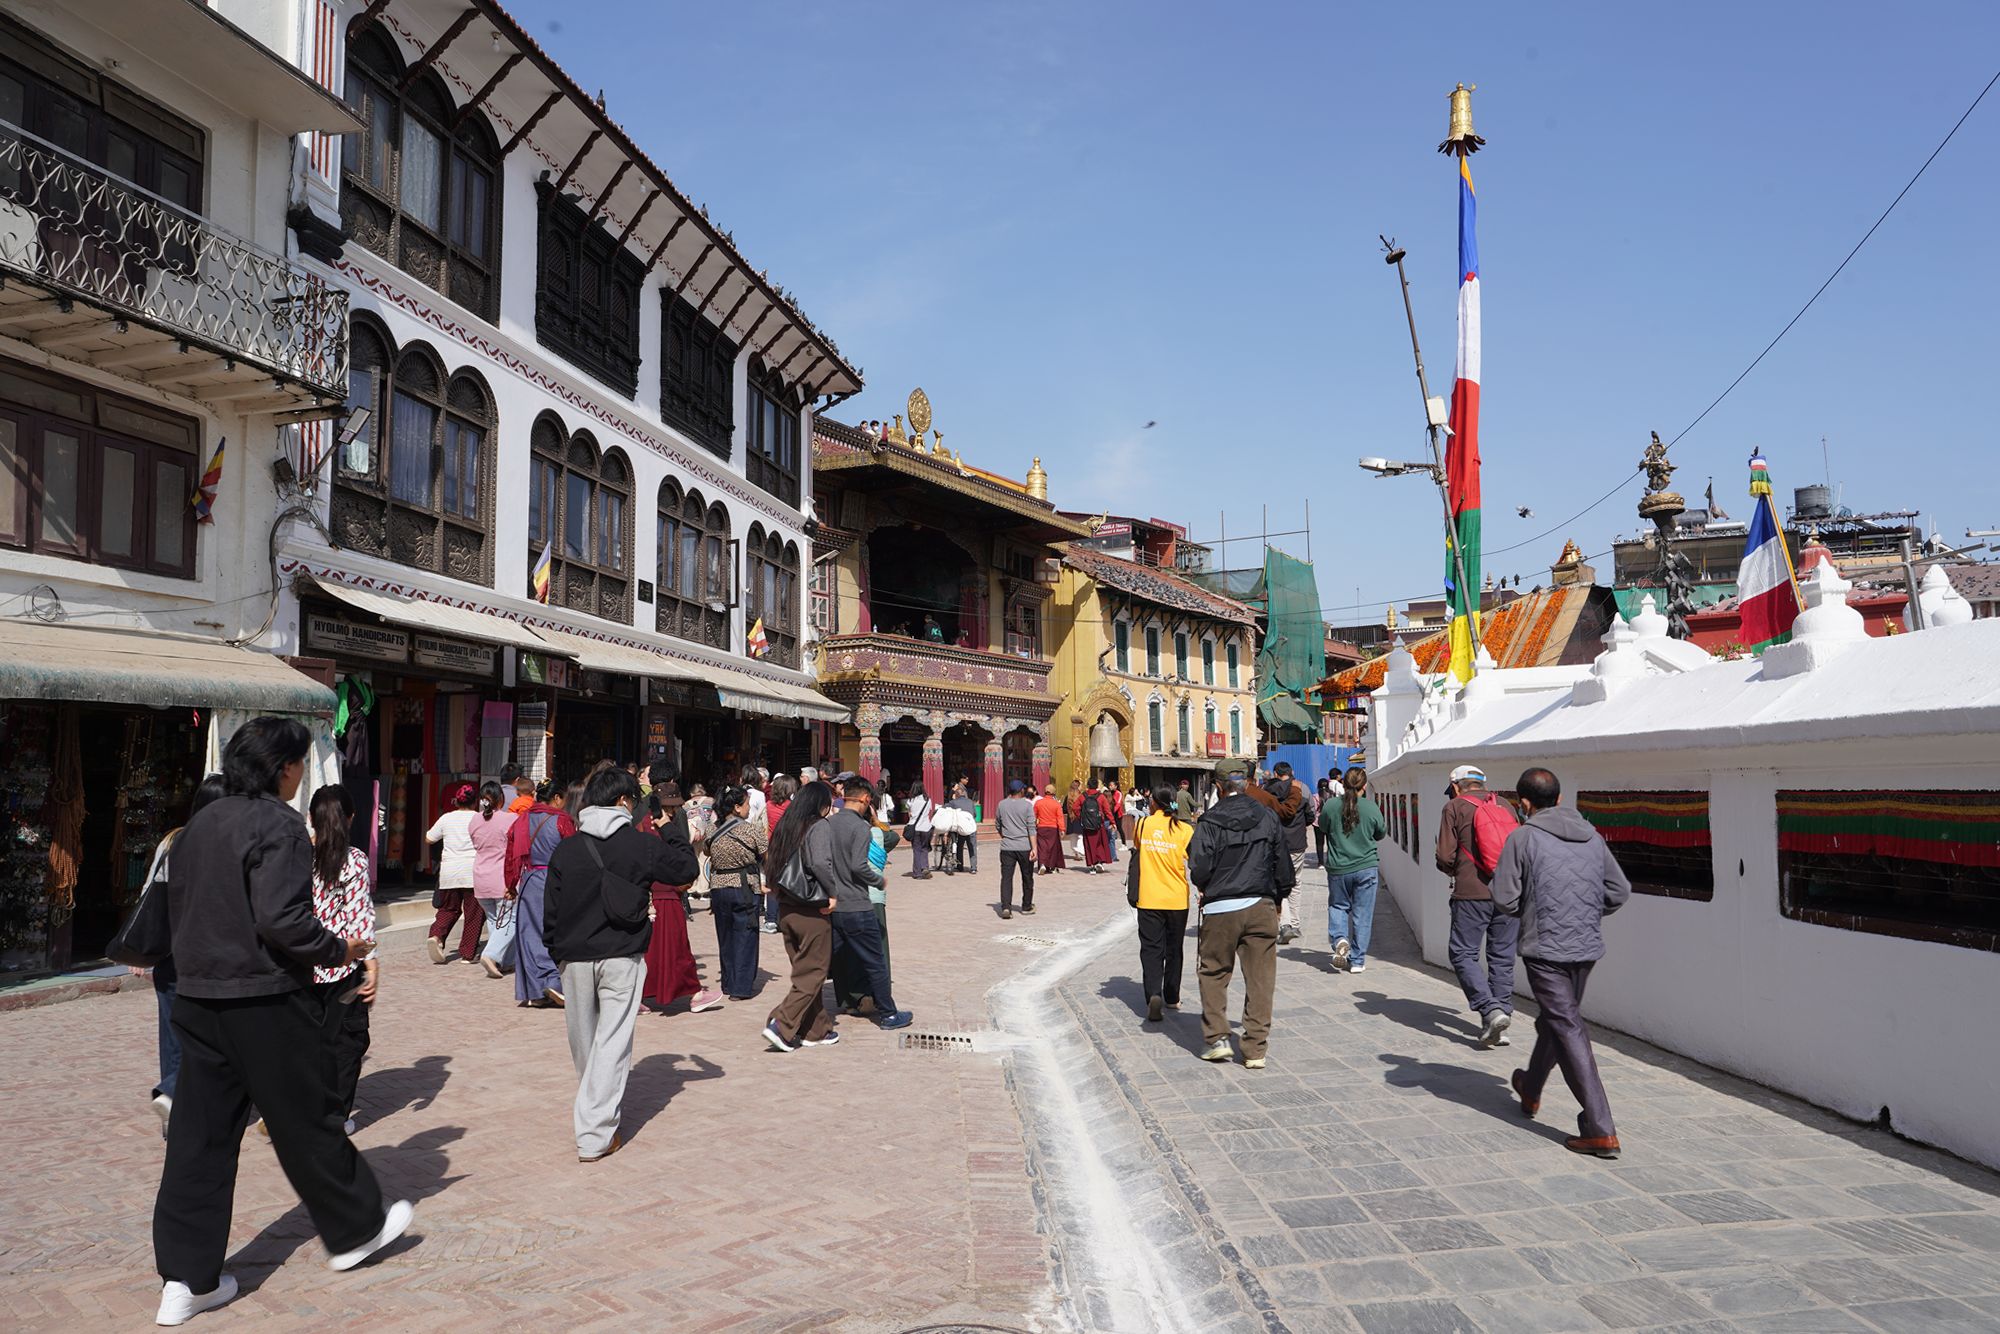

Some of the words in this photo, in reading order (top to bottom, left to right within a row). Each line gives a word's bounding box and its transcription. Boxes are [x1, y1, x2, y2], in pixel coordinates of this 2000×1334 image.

[314, 620, 349, 636] HYOLMO
[352, 627, 405, 646] HANDICRAFTS
[438, 642, 469, 657] HANDICRAFTS
